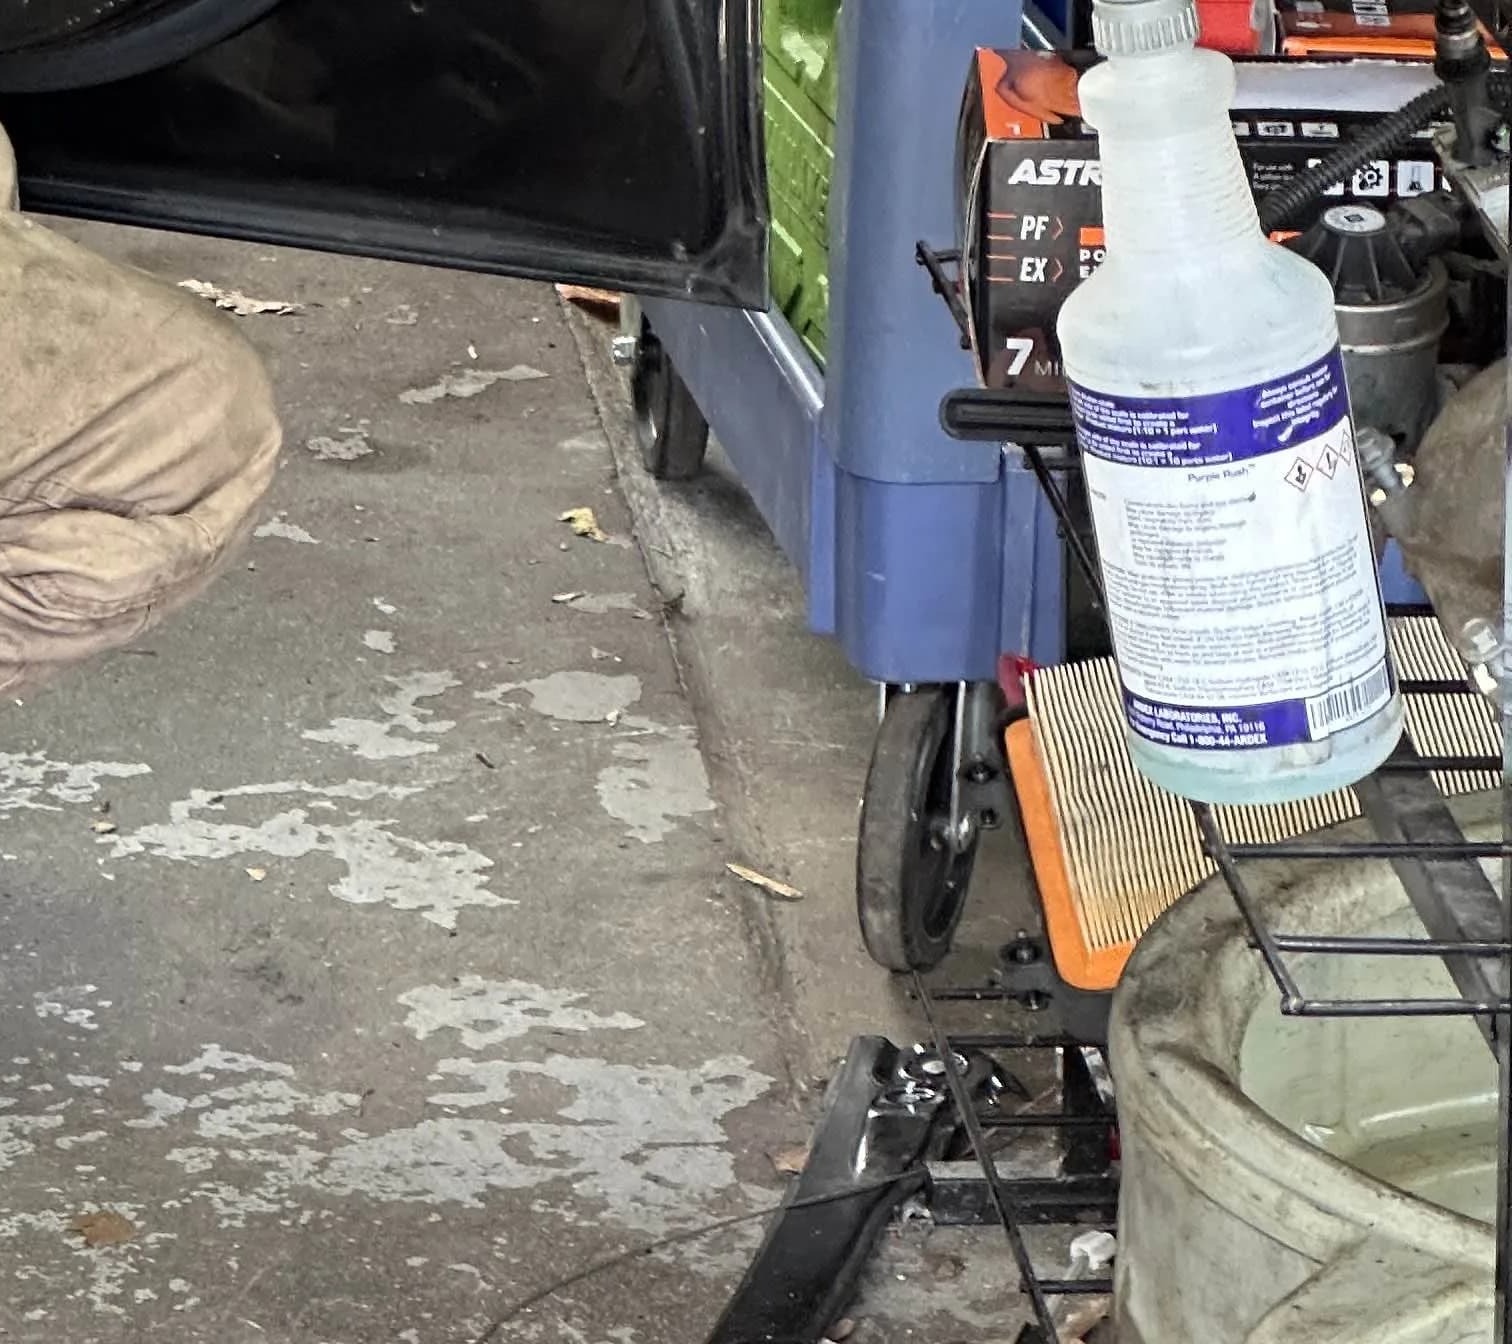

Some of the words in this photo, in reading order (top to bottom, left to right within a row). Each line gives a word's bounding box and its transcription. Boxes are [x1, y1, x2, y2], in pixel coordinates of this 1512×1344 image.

[1007, 158, 1102, 186] ASTR
[1020, 215, 1049, 241] PF
[1019, 257, 1048, 282] EX
[1006, 337, 1034, 376] 7
[1034, 360, 1066, 377] MI
[1187, 472, 1220, 483] Purple
